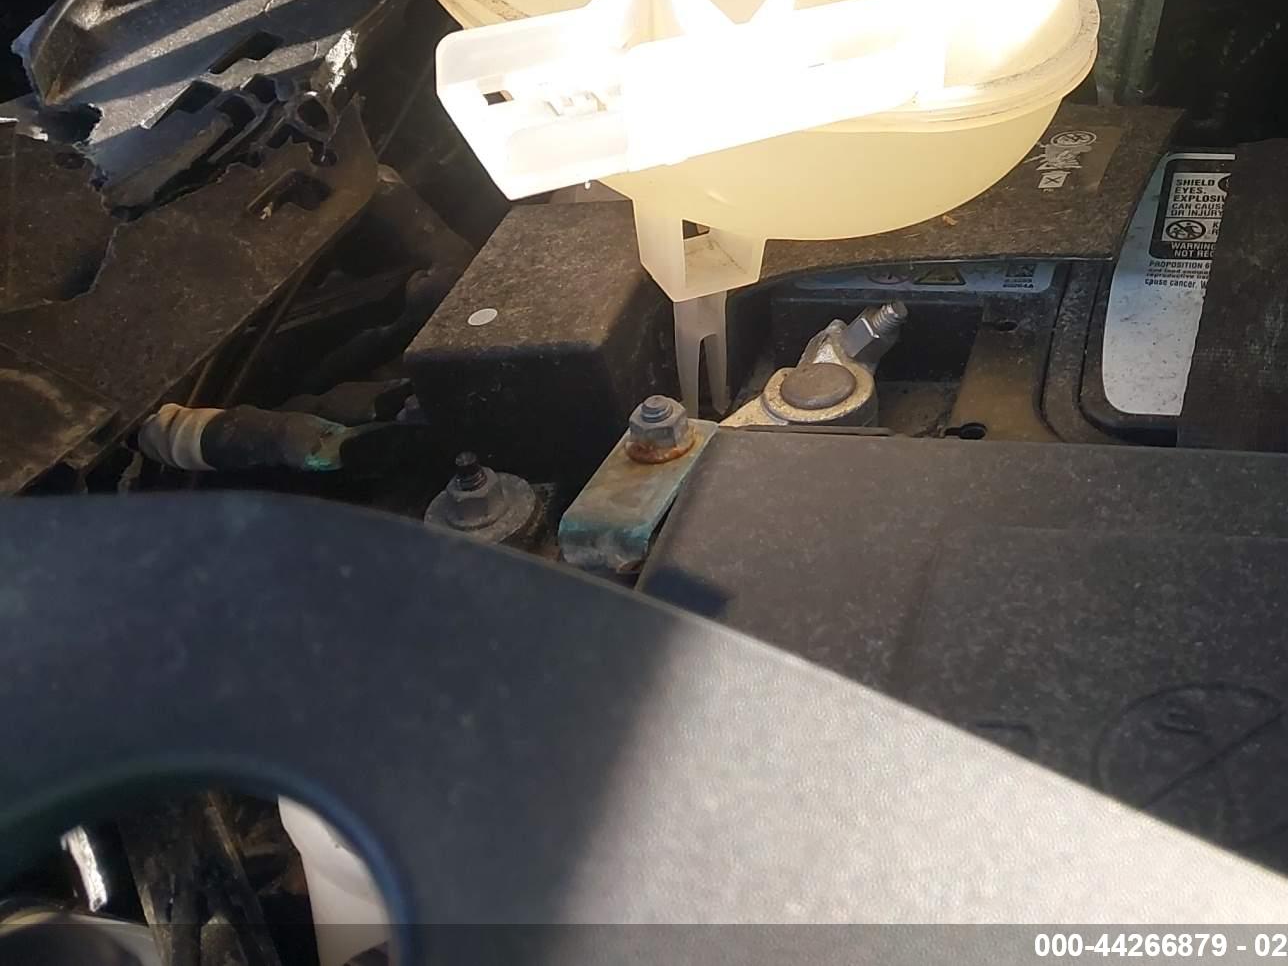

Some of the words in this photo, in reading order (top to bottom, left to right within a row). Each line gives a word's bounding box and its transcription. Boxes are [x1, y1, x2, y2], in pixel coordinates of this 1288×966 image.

[1176, 179, 1216, 187] SHIELD
[1174, 250, 1193, 258] NOT
[1149, 260, 1203, 269] PROPOSITION
